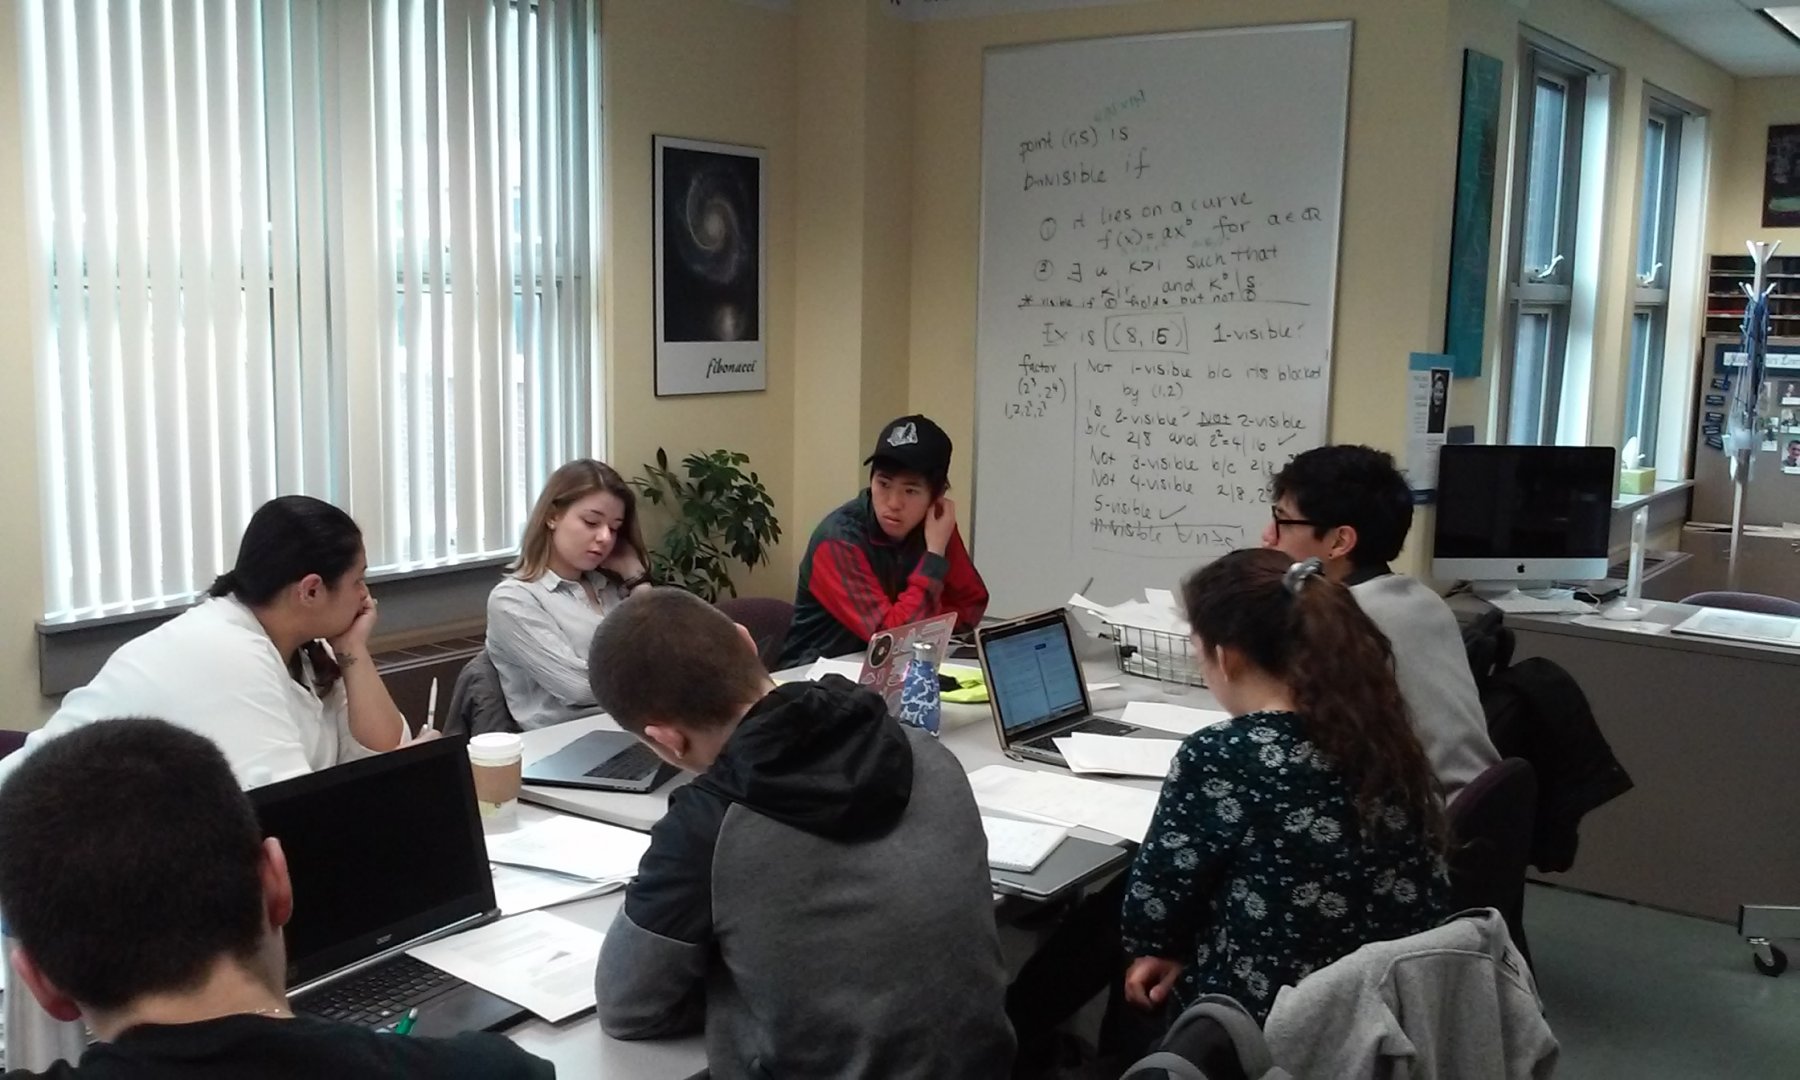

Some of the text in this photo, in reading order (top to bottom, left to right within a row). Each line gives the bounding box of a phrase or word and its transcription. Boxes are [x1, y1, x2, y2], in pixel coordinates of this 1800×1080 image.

[1019, 132, 1053, 163] point
[1111, 126, 1129, 141] is
[1125, 147, 1151, 179] if
[1073, 212, 1086, 230] it
[1101, 206, 1132, 226] lies
[1142, 204, 1162, 218] on
[1171, 201, 1182, 213] a
[1191, 191, 1253, 210] curve
[1213, 215, 1251, 238] for
[1231, 245, 1278, 264] that
[1162, 279, 1195, 293] and
[1125, 294, 1168, 309] holds
[1181, 294, 1204, 305] but
[1213, 291, 1235, 303] not
[705, 357, 758, 379] fibonacci
[1018, 353, 1057, 377] factor
[1088, 358, 1113, 373] Not
[1208, 361, 1232, 379] b/c
[1123, 383, 1140, 407] by
[1085, 416, 1110, 438] b/c
[1168, 433, 1198, 447] and
[1197, 411, 1232, 428] Not
[1237, 410, 1306, 430] 2-visible
[1090, 444, 1116, 466] Not
[1131, 453, 1199, 472] 3-visible
[1212, 455, 1237, 478] b/c
[1091, 467, 1115, 488] Not
[1130, 474, 1194, 495] 4-visible
[1094, 494, 1151, 520] 5-visible
